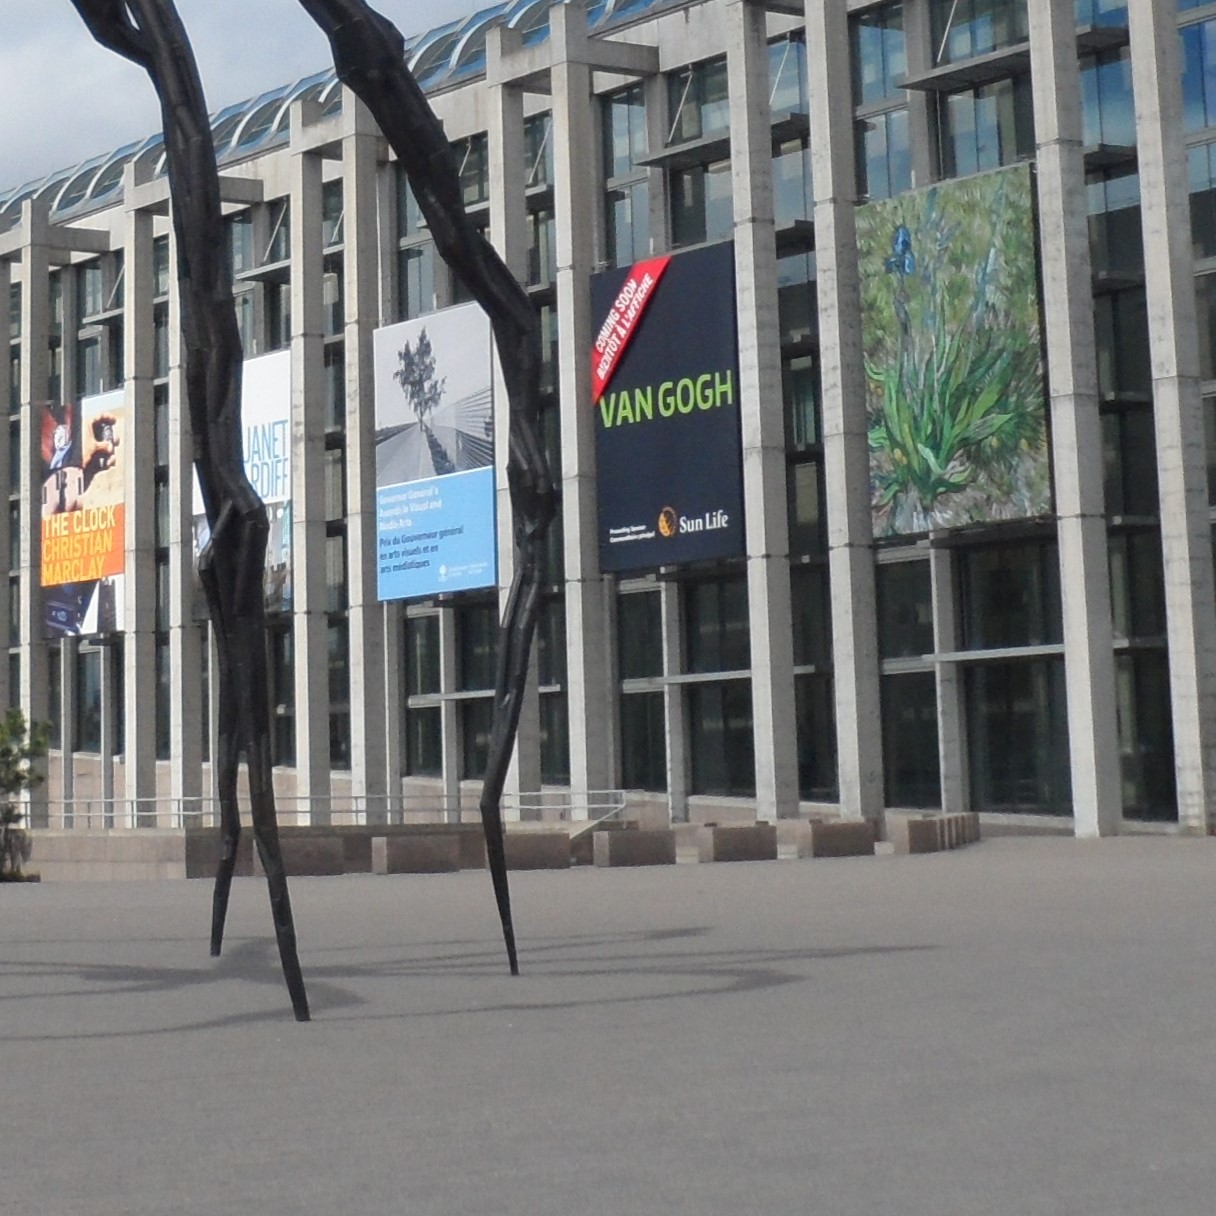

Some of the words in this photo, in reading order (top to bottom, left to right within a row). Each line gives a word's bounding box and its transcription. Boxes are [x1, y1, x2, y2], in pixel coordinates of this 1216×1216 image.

[595, 308, 620, 353] COMING
[615, 278, 638, 313] SOON
[597, 332, 622, 380] BIENTÔT
[622, 272, 654, 329] L'AFFICHE
[600, 386, 653, 428] VAN
[658, 370, 733, 417] GOGH
[243, 418, 288, 463] JANET
[43, 512, 69, 539] THE
[73, 505, 116, 534] CLOCK
[679, 516, 704, 534] Sun
[705, 509, 729, 530] Life
[43, 529, 113, 562] CHRISTIAN
[42, 556, 106, 585] MARCLAY
